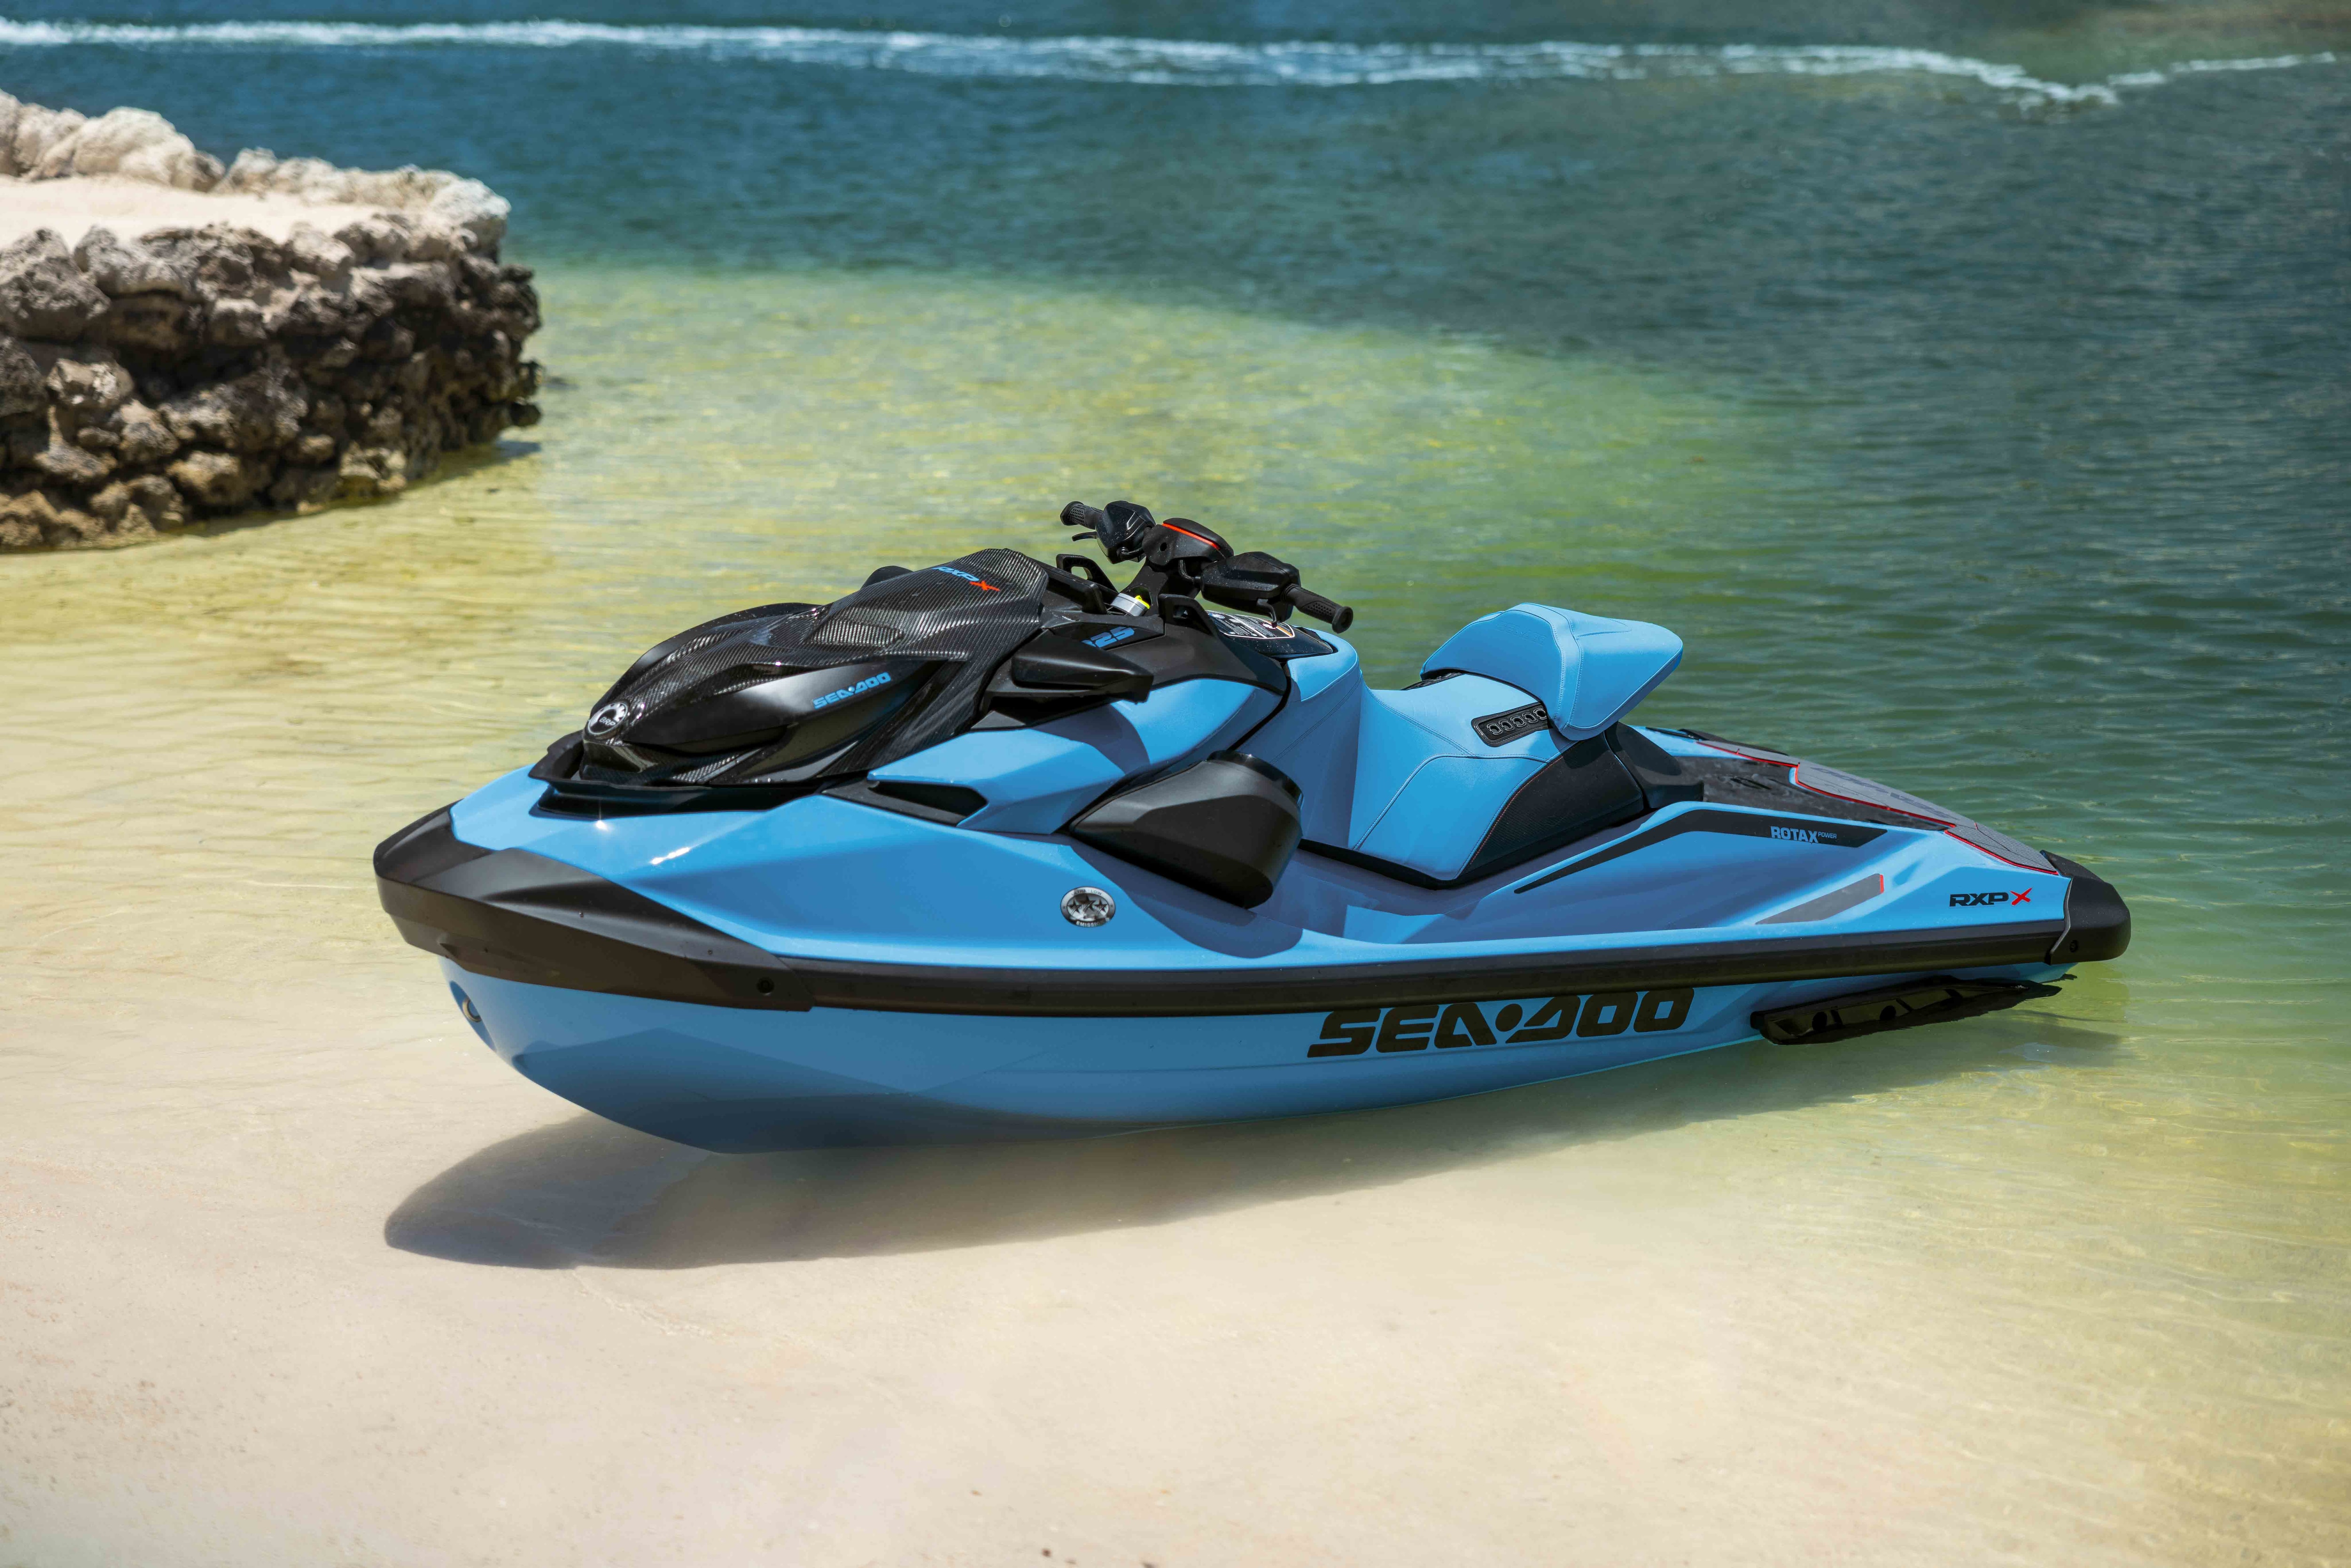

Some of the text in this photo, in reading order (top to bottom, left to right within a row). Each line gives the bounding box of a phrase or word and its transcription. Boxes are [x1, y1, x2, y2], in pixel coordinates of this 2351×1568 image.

[931, 567, 979, 581] RXP
[599, 717, 616, 725] BRP
[1771, 826, 1819, 843] ROTAX
[1949, 887, 2033, 907] RXP X
[1076, 917, 1110, 927] EMISSIO
